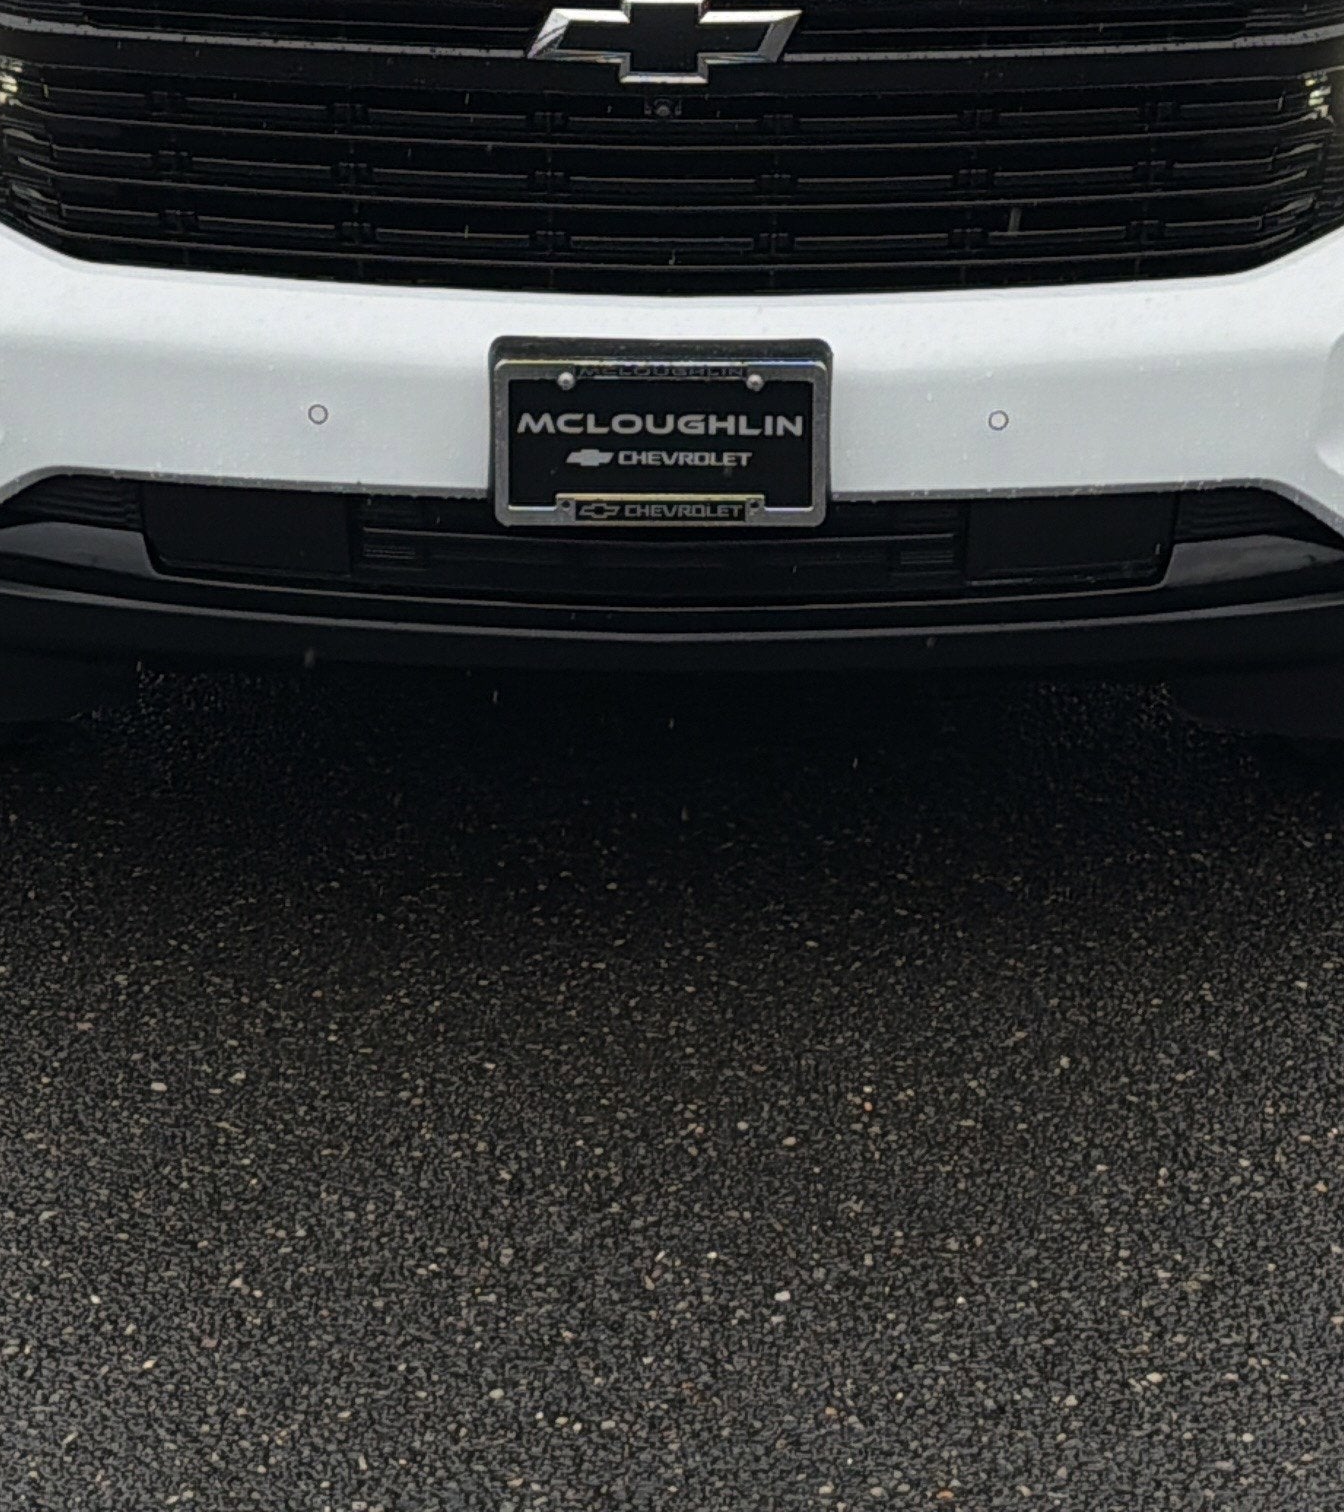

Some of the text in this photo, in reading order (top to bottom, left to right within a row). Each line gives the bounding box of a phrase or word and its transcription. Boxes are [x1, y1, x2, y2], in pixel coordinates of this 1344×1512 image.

[578, 366, 744, 378] MCLOUGHLIN
[516, 412, 804, 437] MCLOUGHLIN
[617, 450, 754, 467] CHEVROLET
[623, 503, 744, 519] CHEVROLET
